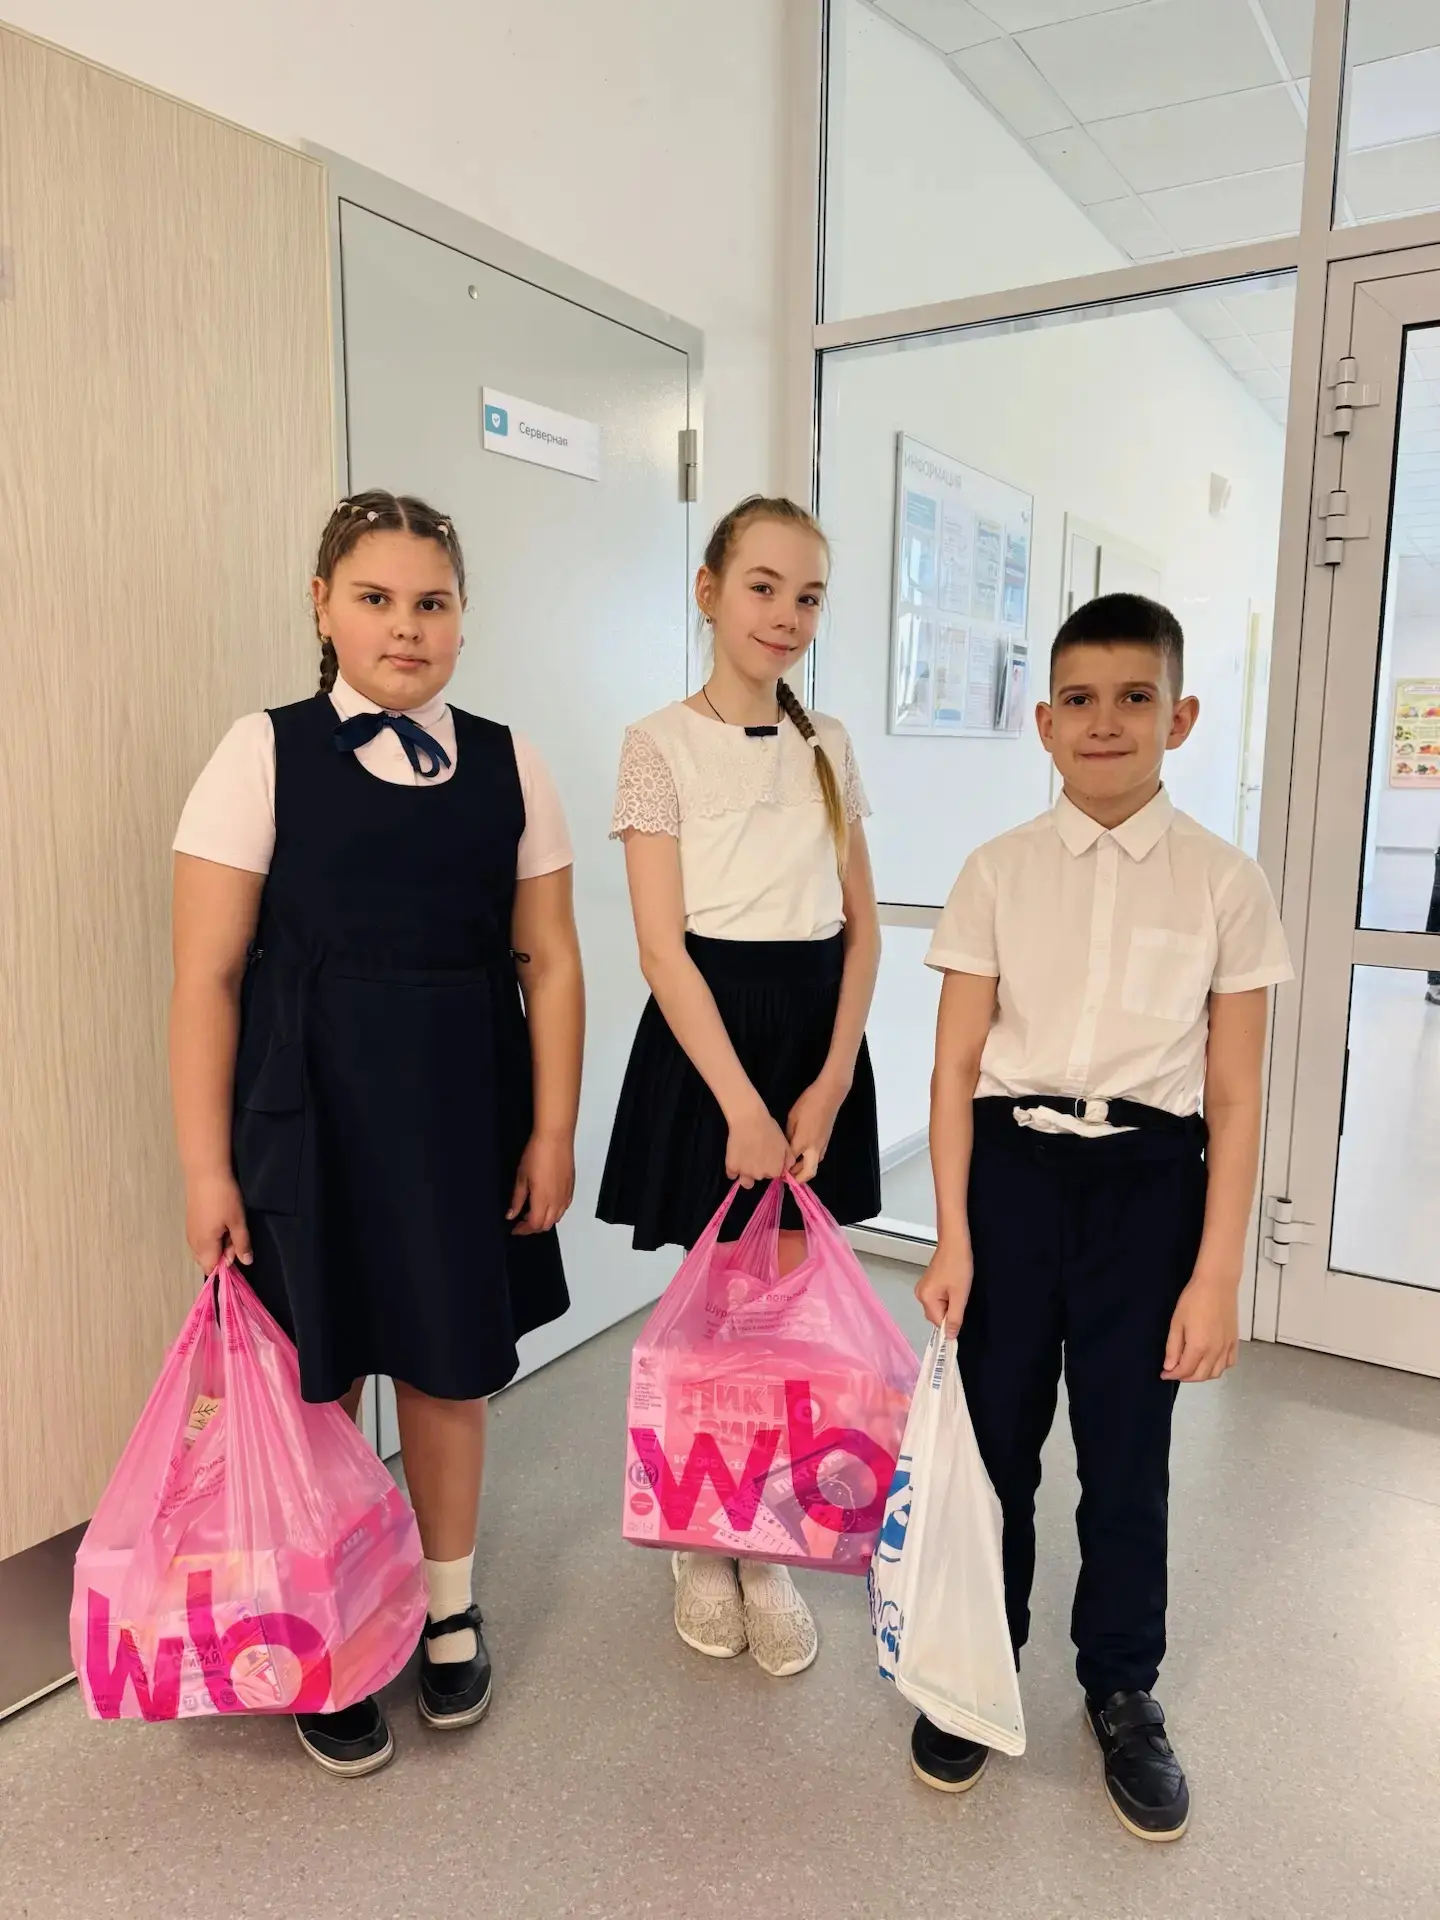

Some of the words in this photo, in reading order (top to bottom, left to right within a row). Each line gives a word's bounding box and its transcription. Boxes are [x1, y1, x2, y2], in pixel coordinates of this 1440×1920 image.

[519, 421, 568, 447] Серверная
[904, 450, 963, 491] ИНФОРМАЦИЯ
[628, 1379, 898, 1538] wb
